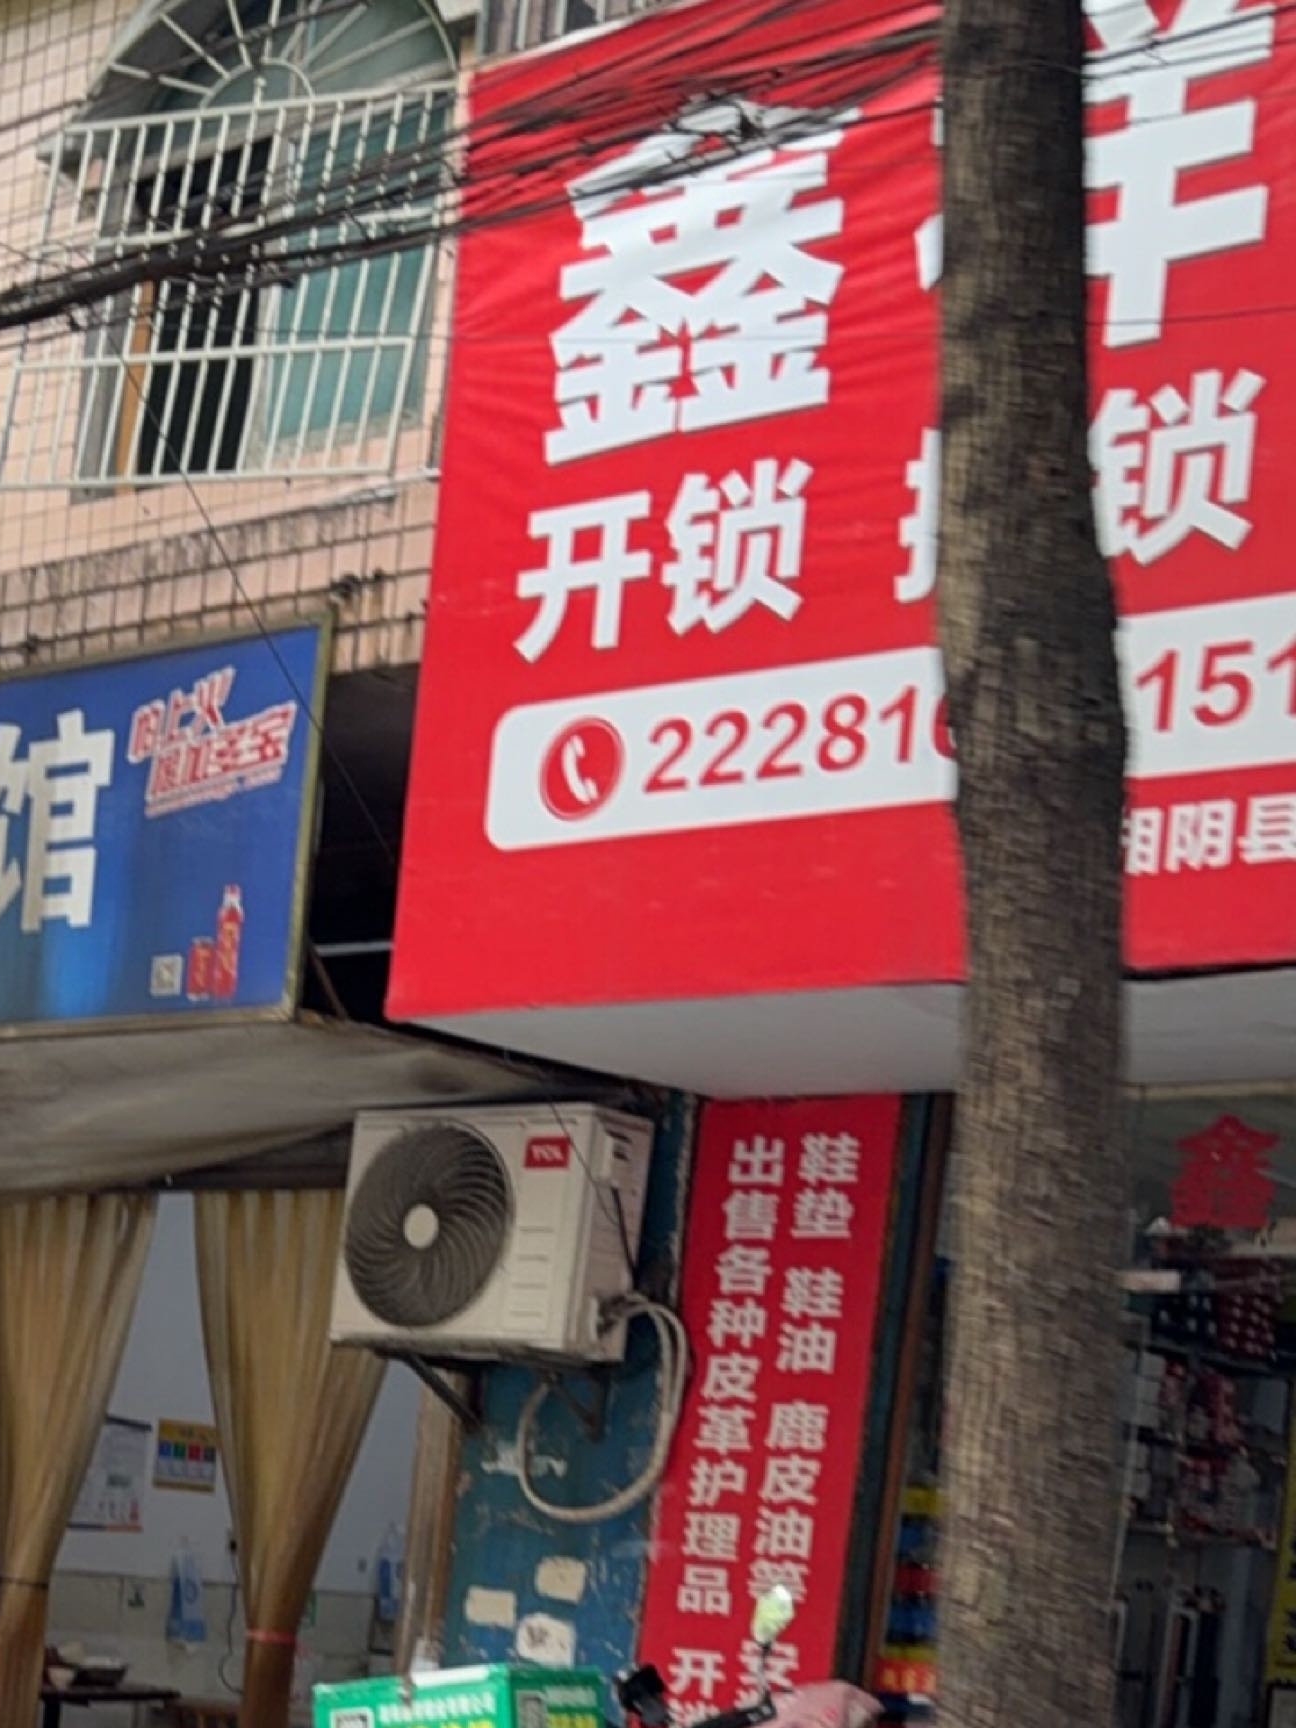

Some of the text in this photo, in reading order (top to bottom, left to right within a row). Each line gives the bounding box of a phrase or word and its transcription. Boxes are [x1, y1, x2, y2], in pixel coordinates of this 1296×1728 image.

[516, 458, 813, 722] 开锁
[676, 1133, 785, 1617] 出售各种皮革护理品
[776, 1266, 845, 1375] 鞋油
